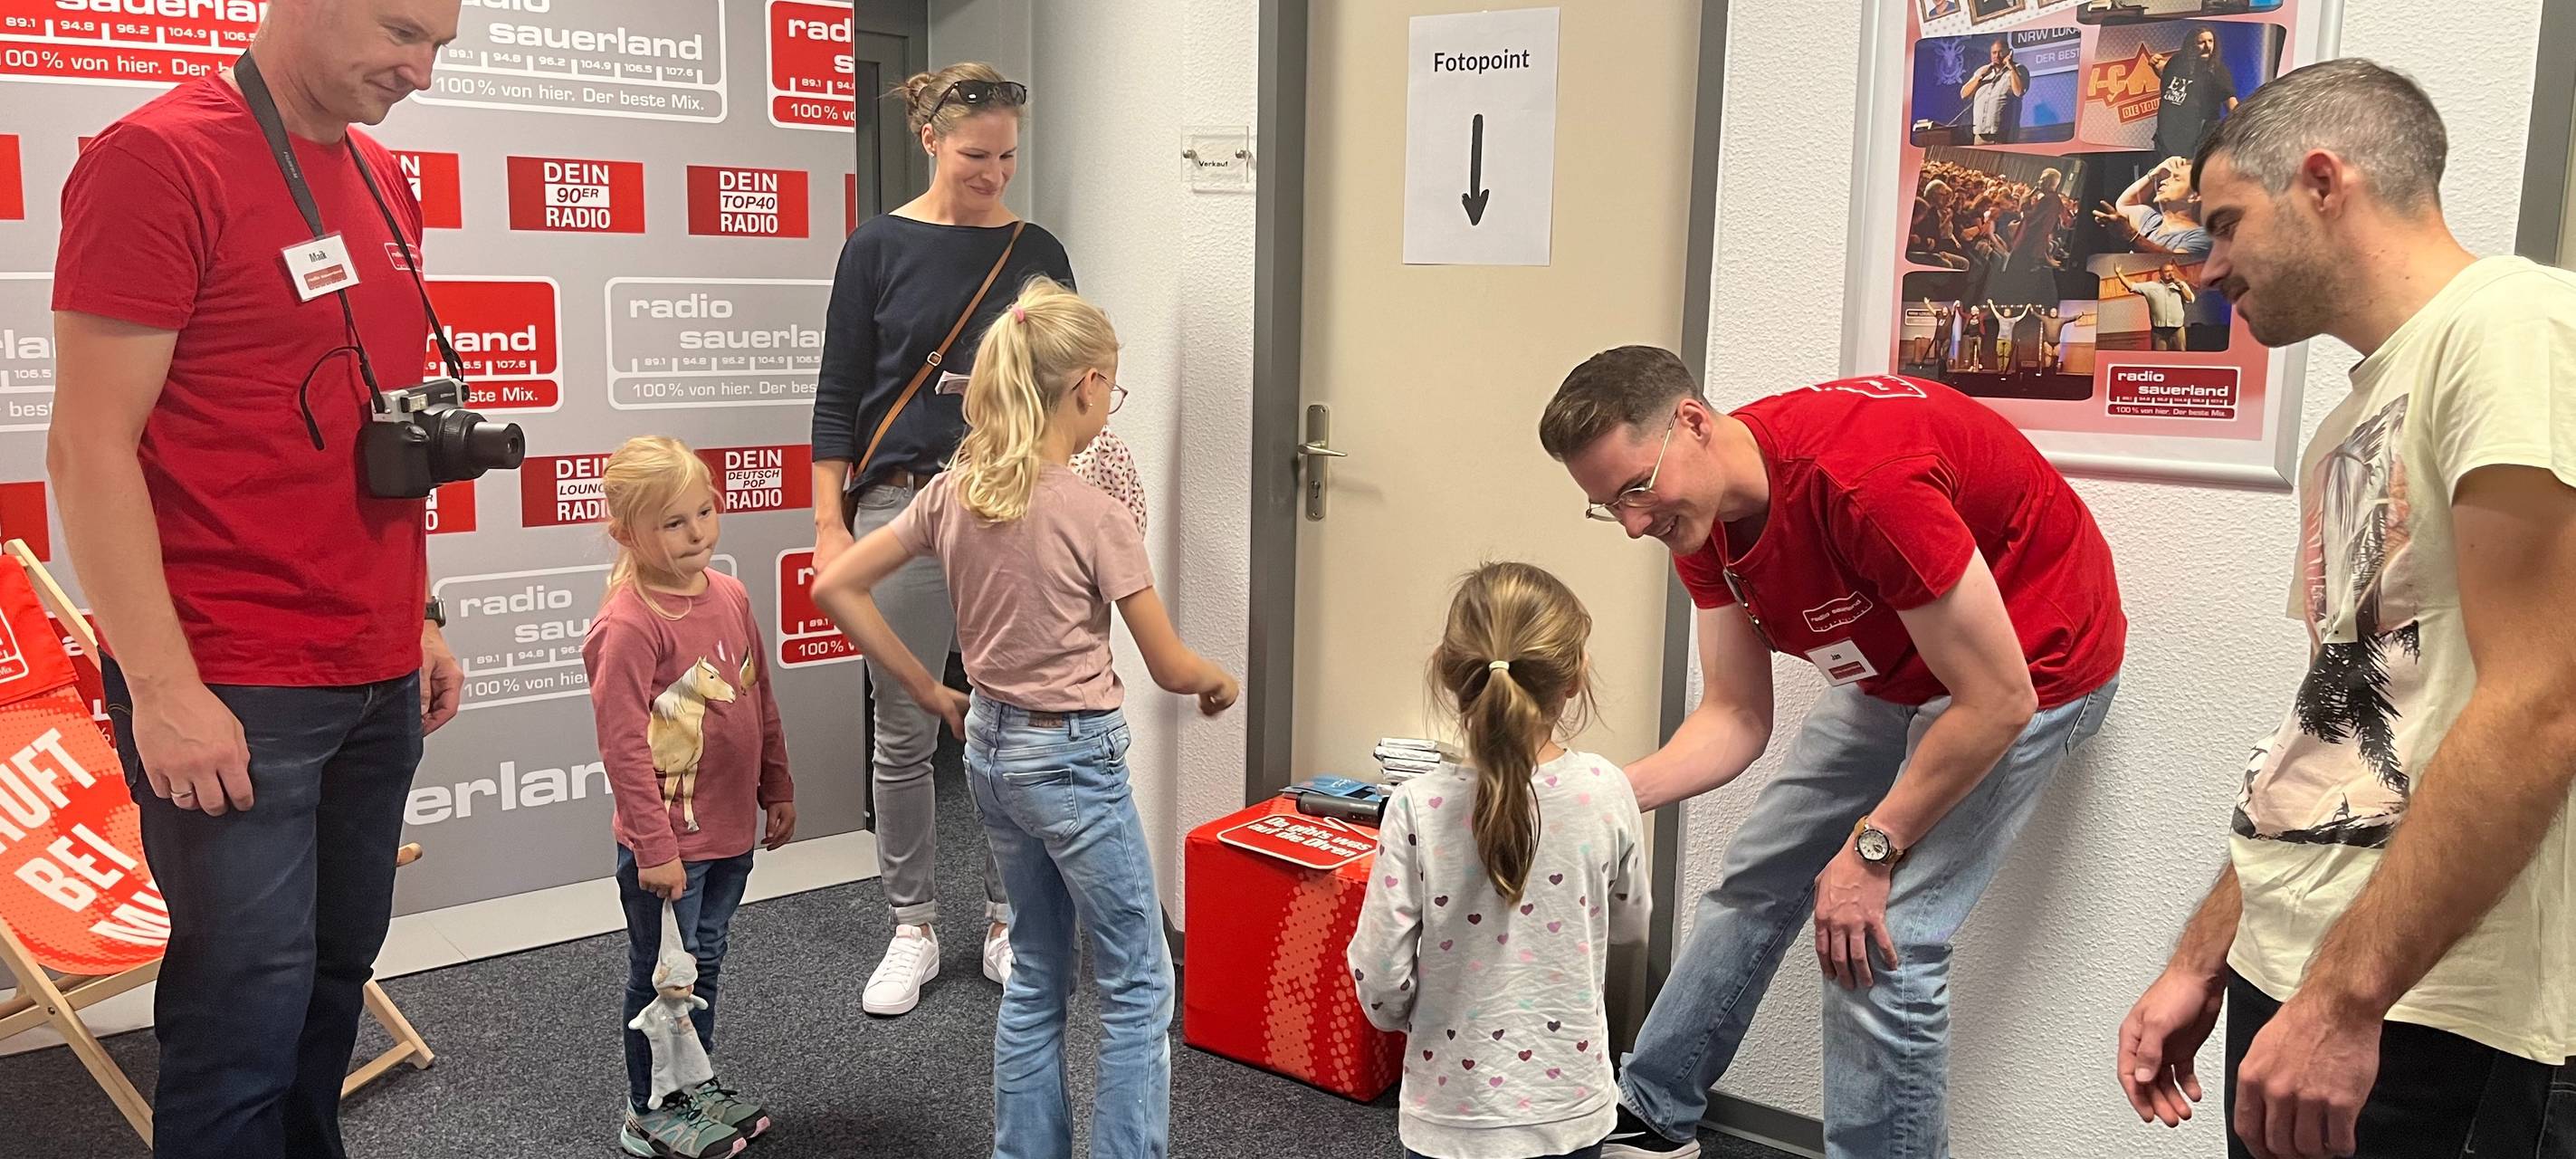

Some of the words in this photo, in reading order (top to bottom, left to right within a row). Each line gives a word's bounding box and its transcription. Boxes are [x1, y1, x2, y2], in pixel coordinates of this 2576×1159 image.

[5, 16, 36, 28] 89.1
[60, 20, 95, 31] 94.8
[116, 24, 149, 34] 96.2
[168, 27, 206, 38] 104.9
[2018, 28, 2048, 43] NRW
[489, 23, 702, 61] sauerland
[71, 57, 109, 72] von
[117, 55, 162, 74] hier.
[171, 58, 211, 76] Der
[449, 49, 473, 59] 89.1
[493, 53, 521, 62] 94.8
[539, 56, 566, 66] 96.2
[580, 60, 611, 70] 104.9
[624, 63, 653, 73] 106.5
[665, 67, 693, 77] 107.6
[1435, 49, 1530, 74] Fotopoint
[2036, 53, 2056, 64] DER
[801, 78, 822, 87] 89.1
[501, 85, 532, 99] von
[539, 84, 576, 101] hier.
[583, 88, 614, 104] Der
[620, 91, 665, 107] beste
[672, 94, 705, 110] Mix.
[543, 162, 610, 184] DEIN
[720, 170, 778, 192] DEIN
[722, 196, 776, 210] TOP40
[546, 207, 611, 229] RADIO
[720, 214, 778, 234] RADIO
[630, 293, 733, 319] radio
[680, 324, 826, 349] sauerla
[496, 359, 527, 369] 107.6
[644, 358, 665, 366] 89.1
[758, 356, 785, 364] 104.9
[14, 369, 52, 378] 106.5
[2117, 370, 2165, 382] radio
[502, 387, 539, 402] Mix.
[689, 387, 715, 396] von
[721, 382, 752, 395] hier.
[759, 381, 787, 394] Der
[2138, 385, 2228, 397] sauerland
[725, 449, 782, 469] DEIN
[728, 469, 779, 480] DEUTSCH
[743, 479, 766, 488] POP
[726, 489, 782, 510] RADIO
[460, 586, 572, 618] radio
[476, 654, 500, 665] 89.1
[518, 649, 544, 660] 94.8
[525, 678, 553, 690] von
[1247, 823, 1284, 834] auf
[1275, 831, 1306, 843] die
[1302, 838, 1357, 857] Ohren
[1331, 837, 1372, 851] was
[14, 822, 138, 913] BEI
